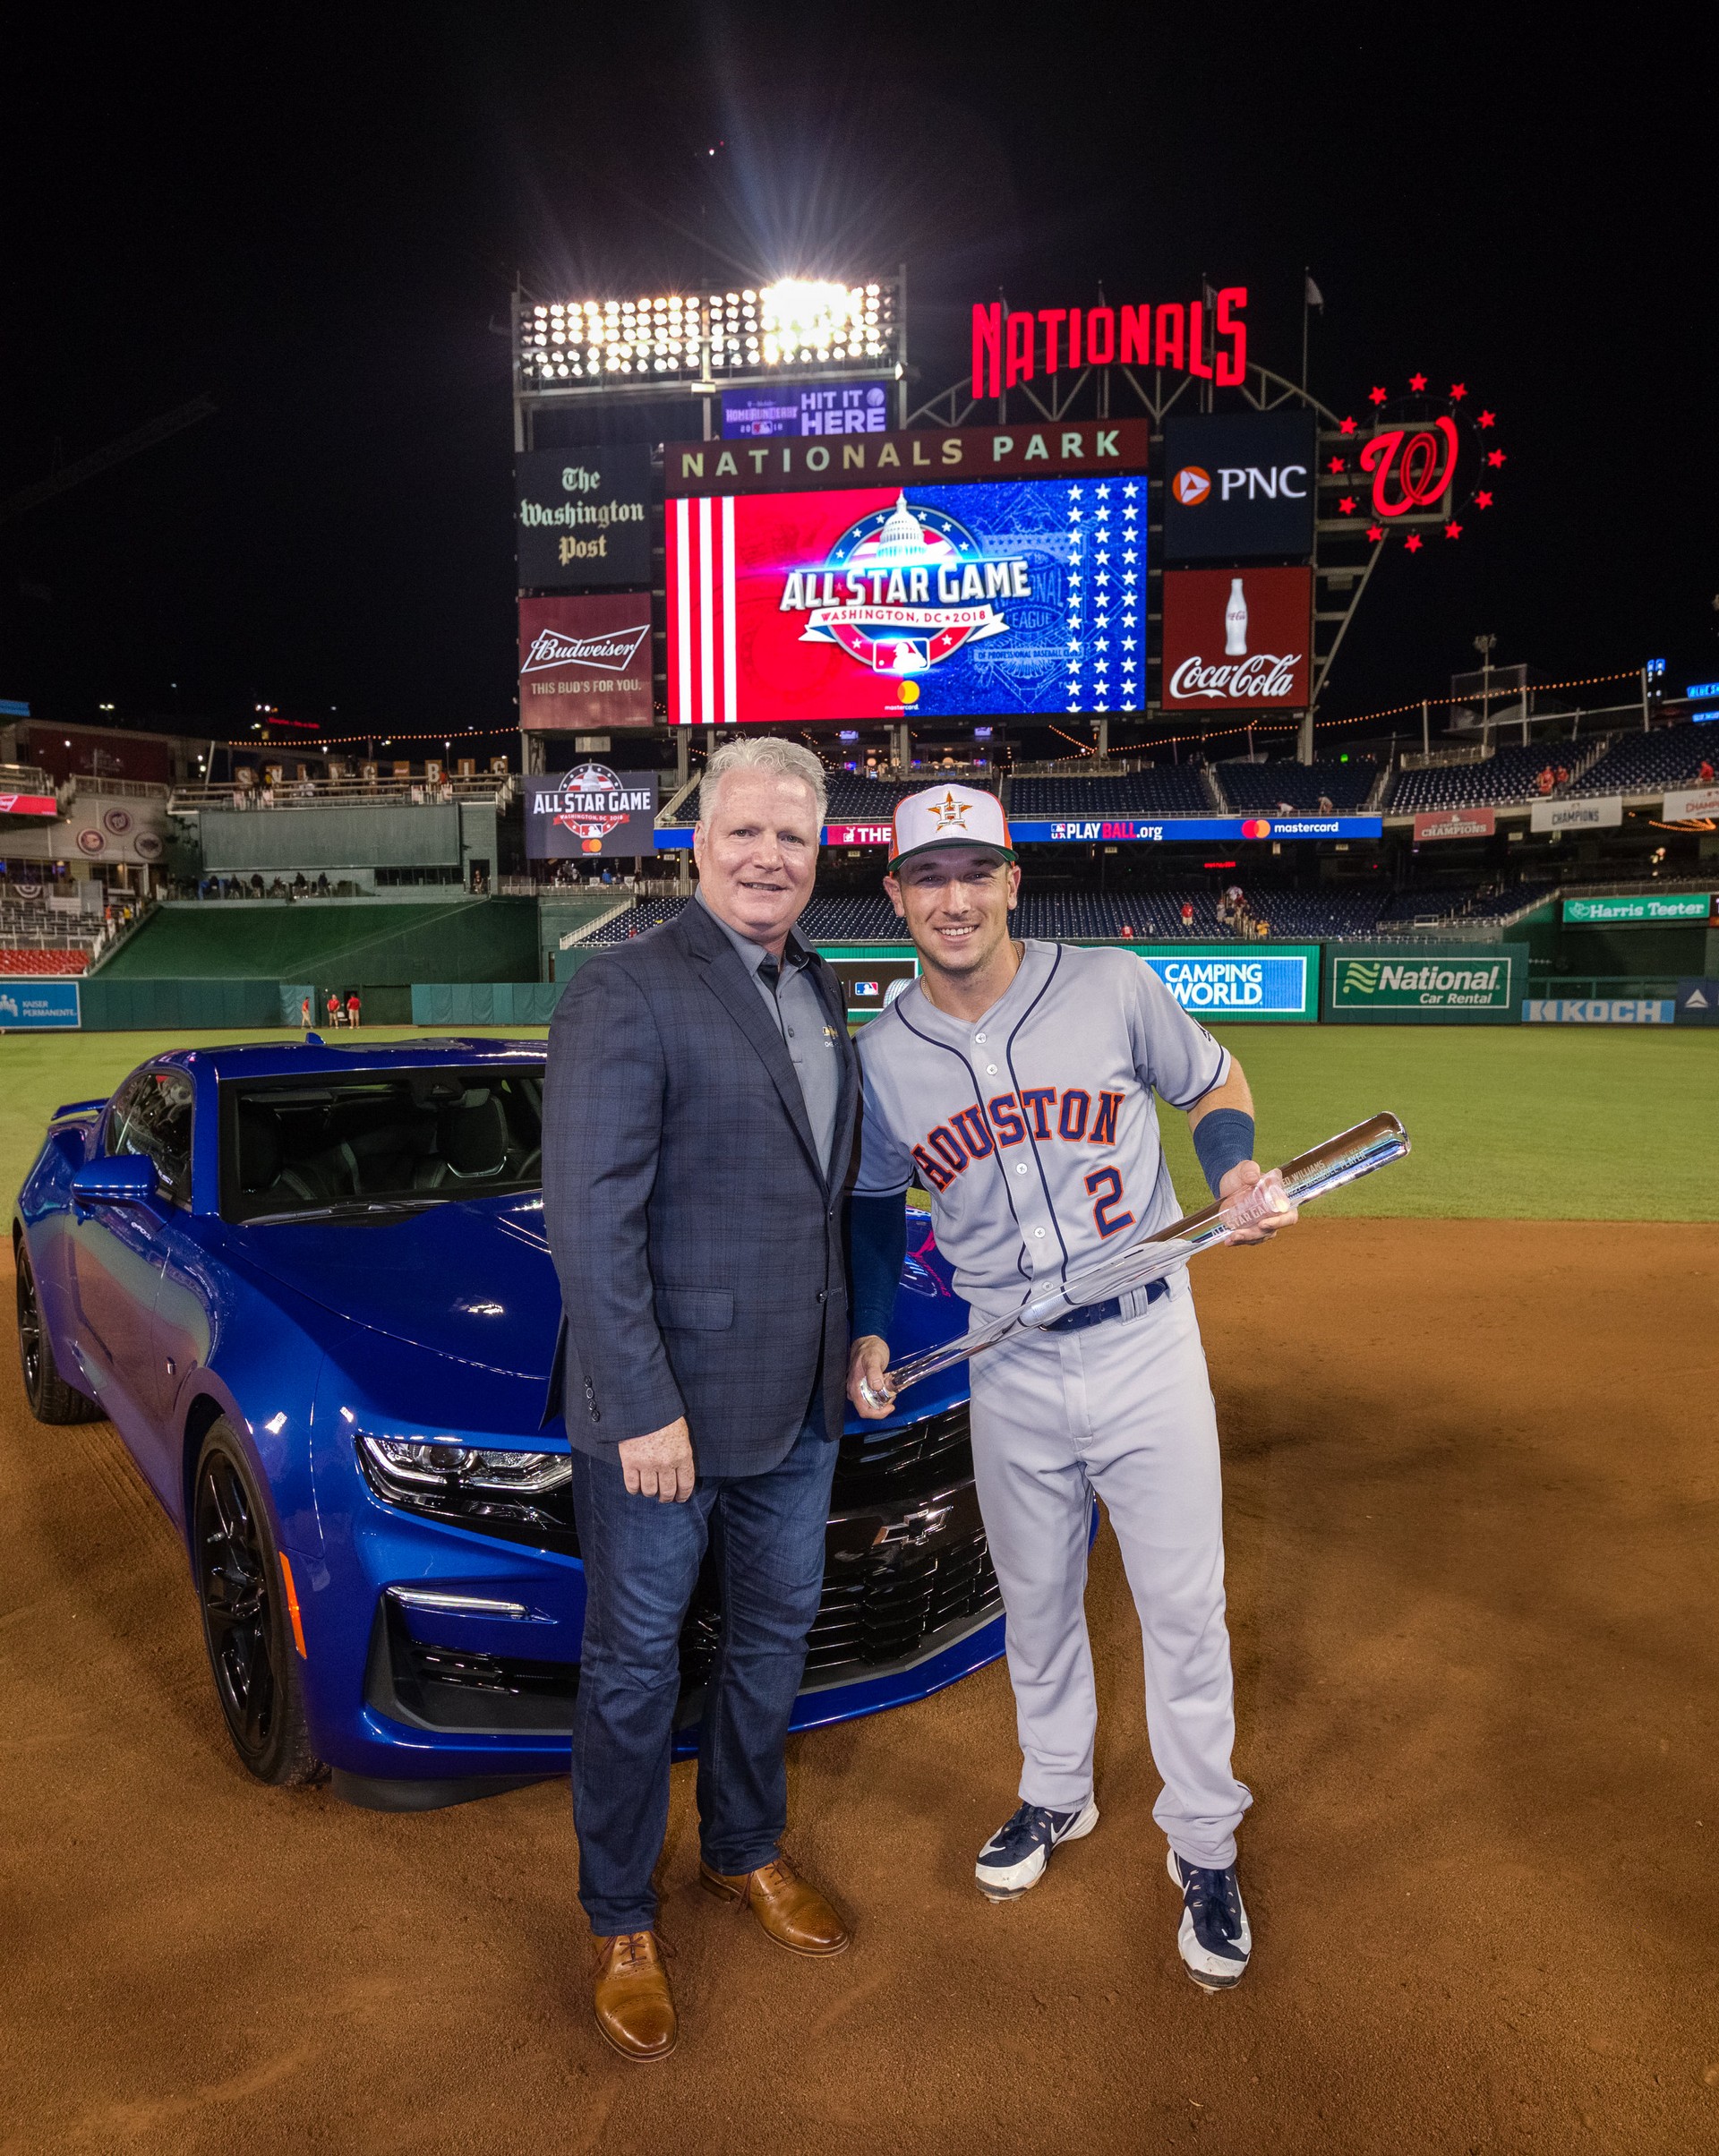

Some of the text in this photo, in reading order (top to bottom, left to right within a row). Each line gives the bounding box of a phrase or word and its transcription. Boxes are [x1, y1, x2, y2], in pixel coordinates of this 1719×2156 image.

[972, 287, 1248, 399] NATIONALS
[801, 389, 863, 411] HIT IT
[801, 407, 886, 436] HERE
[681, 429, 1121, 479] NATIONALS PARK
[561, 466, 601, 493] The
[1218, 465, 1307, 500] PNC
[519, 498, 646, 530] Washington
[559, 533, 608, 567] Post
[779, 560, 1032, 612] ALL STAR GAME
[821, 609, 987, 623] WASHINGTON, DC 2018
[531, 638, 637, 661] Budweiser
[531, 679, 642, 695] THIS BUD'S FOR YOU.
[1168, 654, 1303, 699] Coca-Cola
[533, 791, 652, 815] ALL STAR GAME
[857, 827, 892, 842] THE
[1274, 821, 1339, 834] mastercard
[1421, 824, 1487, 837] CHAMPIONS
[1590, 901, 1705, 919] Harris Teeter
[1165, 963, 1262, 983] CAMPING
[1378, 965, 1500, 991] National
[22, 1000, 48, 1008] KAISER
[1166, 982, 1262, 1005] WORLD
[1419, 992, 1492, 1005] Car Rental
[1558, 1000, 1662, 1022] KOCH
[910, 1086, 1125, 1194] HOUSTON
[1291, 1159, 1325, 1181] WILLIAMS
[1083, 1166, 1135, 1240] 2
[1227, 1211, 1252, 1229] STAR
